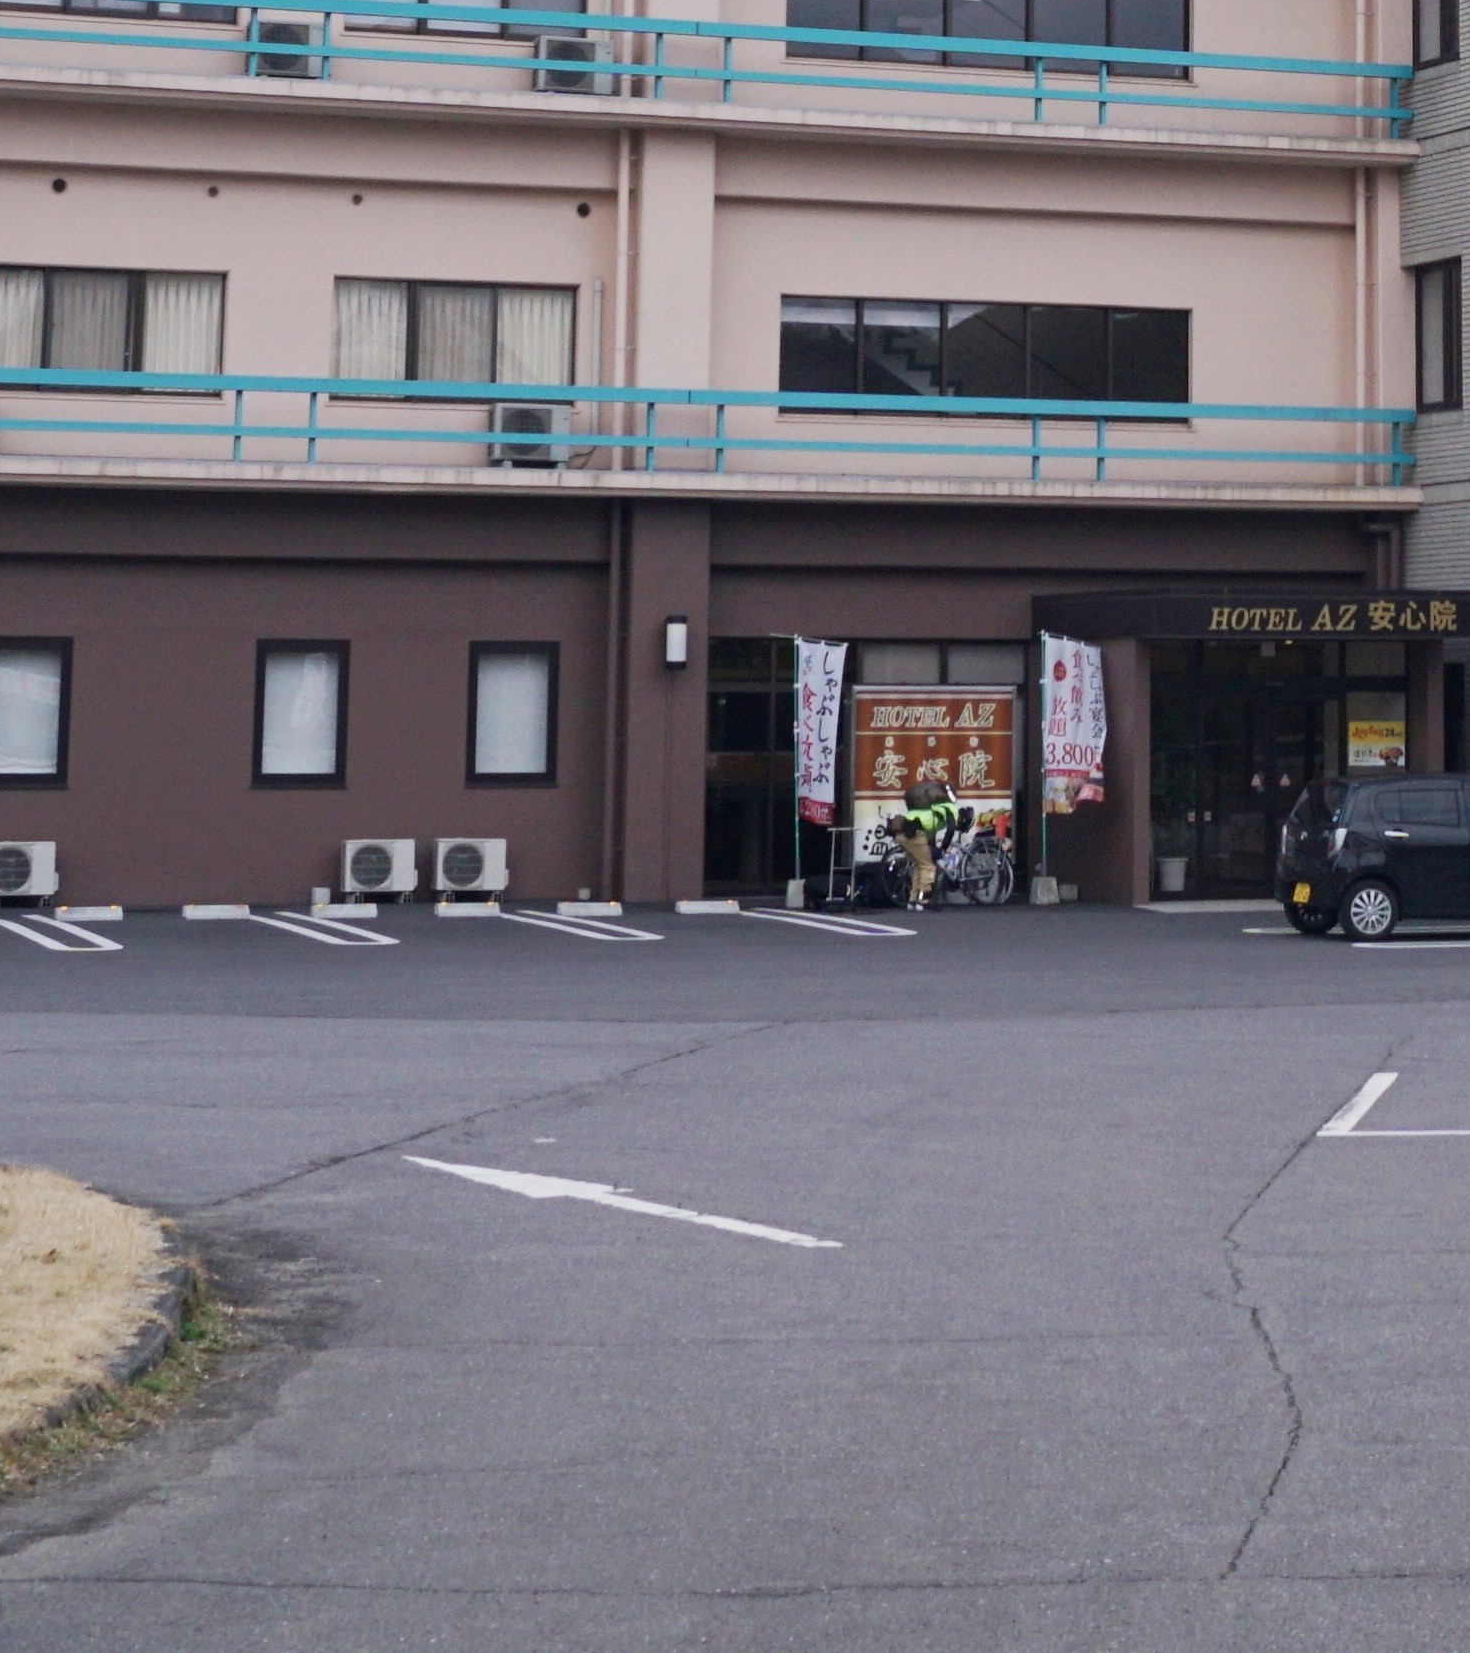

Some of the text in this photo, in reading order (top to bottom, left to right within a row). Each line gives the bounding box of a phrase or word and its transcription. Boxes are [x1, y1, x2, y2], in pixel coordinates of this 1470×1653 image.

[1208, 600, 1457, 632] HOTEL AZ 安心院
[813, 651, 838, 784] しゃぶしゃぶ
[870, 702, 996, 728] HOTEL AZ
[872, 750, 996, 789] 安心院
[1046, 742, 1094, 767] 3,800
